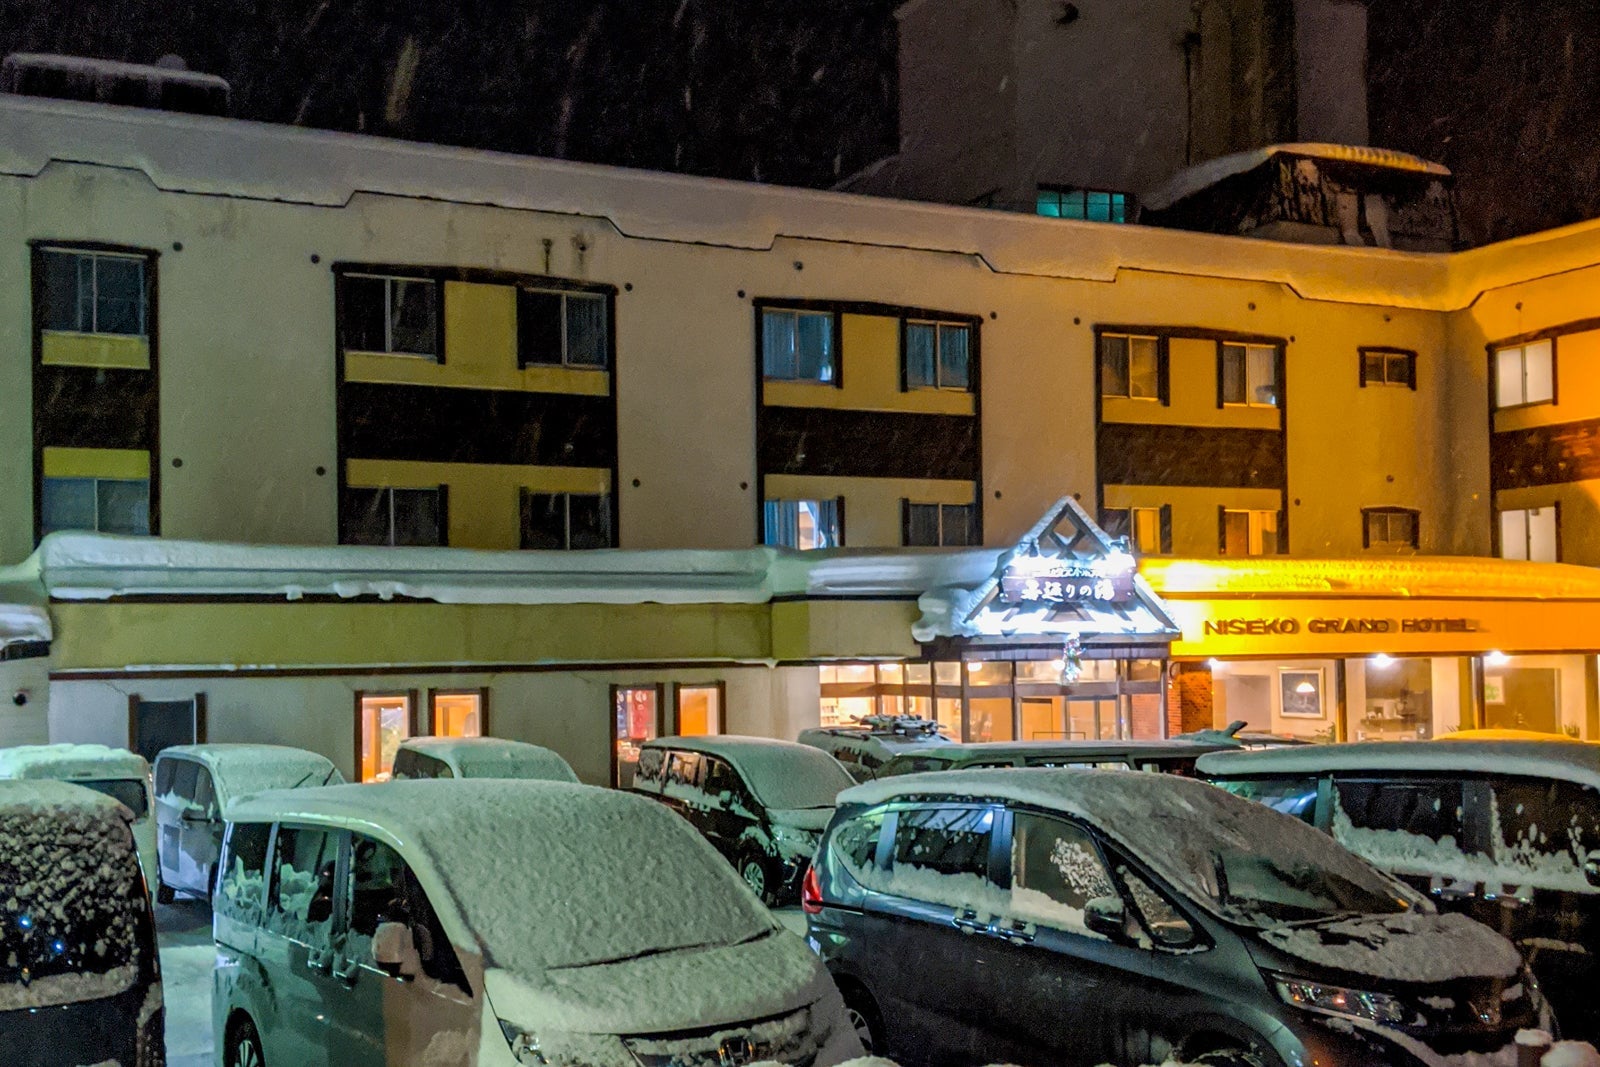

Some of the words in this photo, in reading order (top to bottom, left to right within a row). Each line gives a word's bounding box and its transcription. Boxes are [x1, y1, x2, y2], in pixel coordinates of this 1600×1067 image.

[1204, 618, 1296, 635] NISEKO
[1308, 618, 1391, 634] GRAND
[1401, 618, 1478, 633] HOTEL
